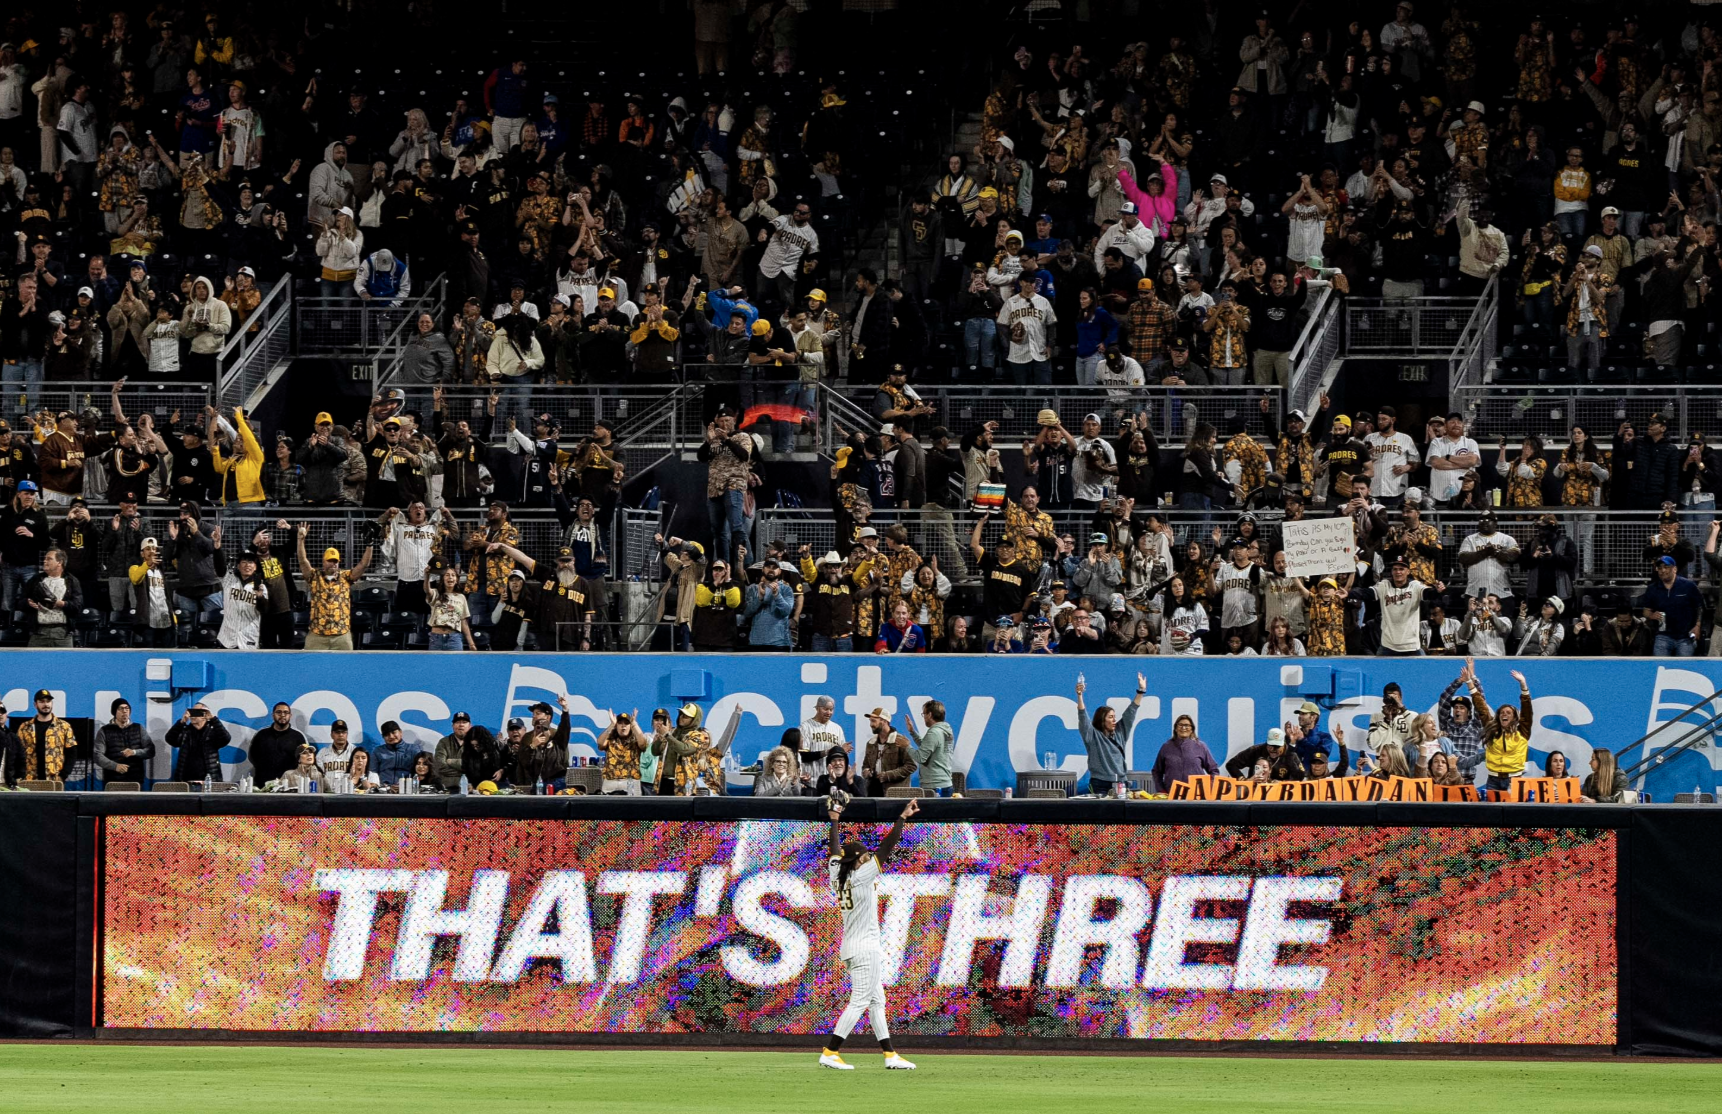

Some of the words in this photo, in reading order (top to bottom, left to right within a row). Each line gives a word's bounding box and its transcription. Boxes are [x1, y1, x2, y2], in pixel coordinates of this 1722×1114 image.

[912, 219, 927, 242] SD
[1010, 307, 1044, 322] PADRES
[352, 364, 374, 380] EXIT
[1402, 365, 1429, 380] EXIT
[1328, 449, 1358, 460] PADRES
[1374, 444, 1402, 456] ADRES
[1396, 717, 1408, 734] SD
[836, 889, 854, 910] 23
[314, 868, 814, 987] THAT'S
[876, 873, 1344, 991] THREE
